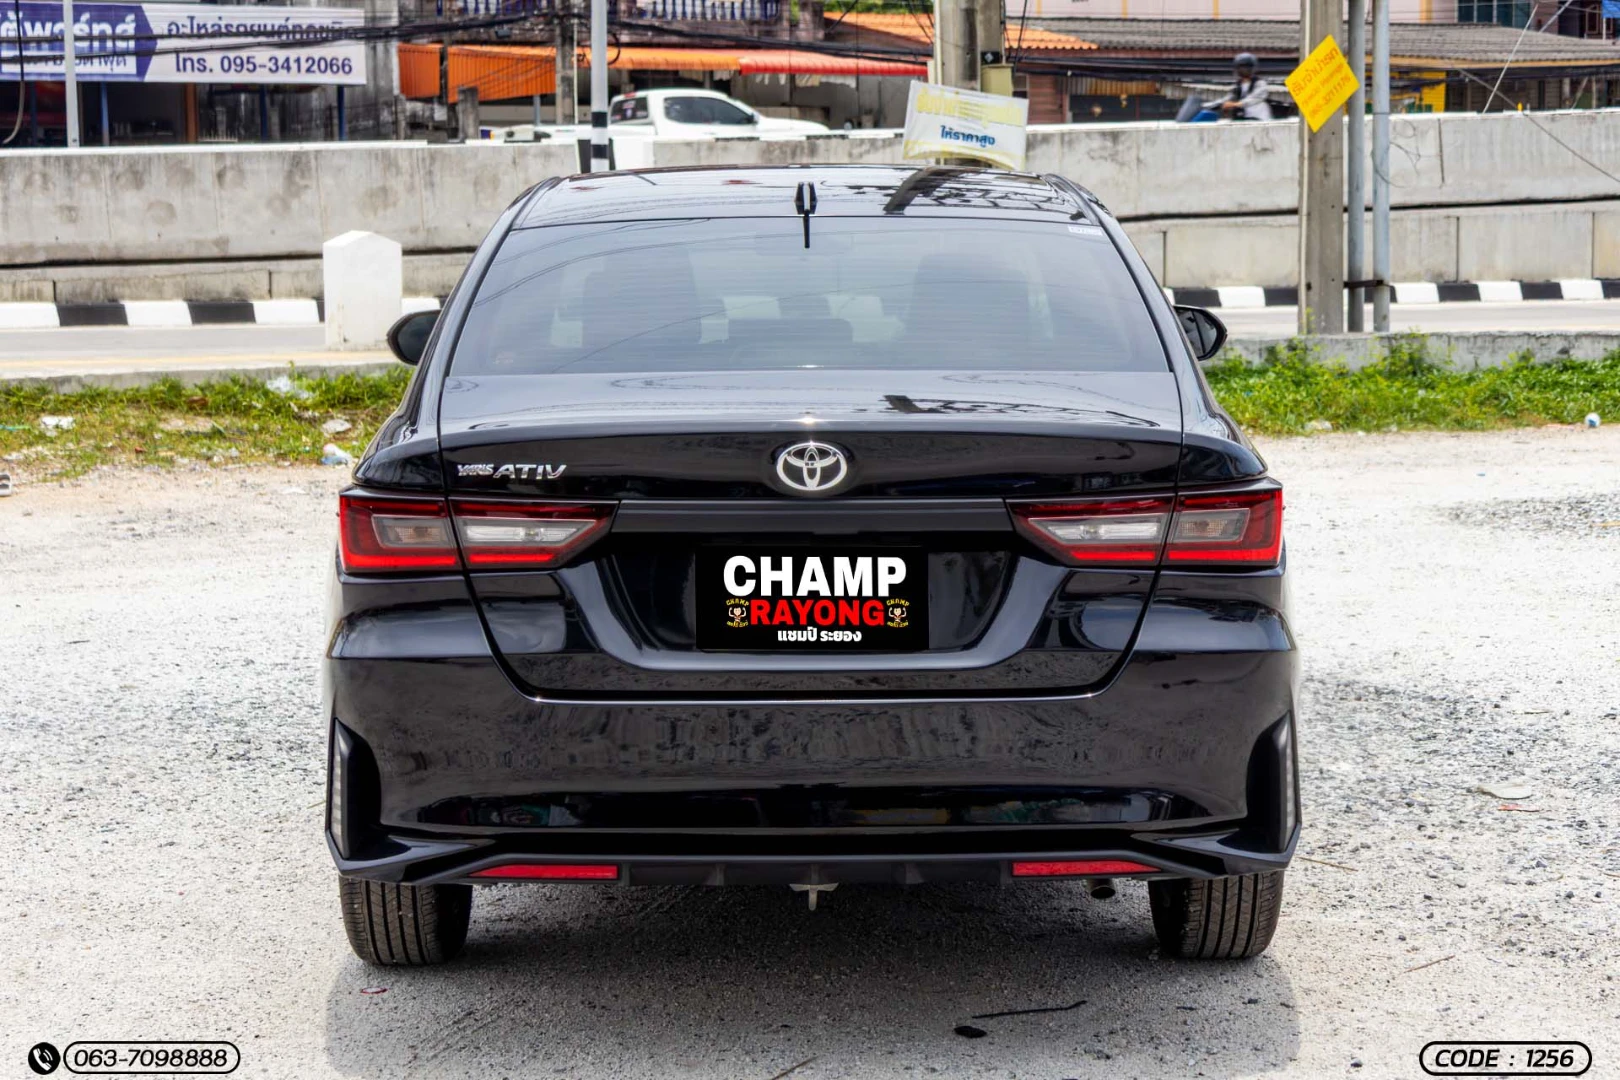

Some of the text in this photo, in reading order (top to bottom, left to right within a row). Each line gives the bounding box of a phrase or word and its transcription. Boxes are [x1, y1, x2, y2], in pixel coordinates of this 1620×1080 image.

[220, 55, 353, 75] 095-3412066
[457, 464, 567, 479] YARIS ATIV
